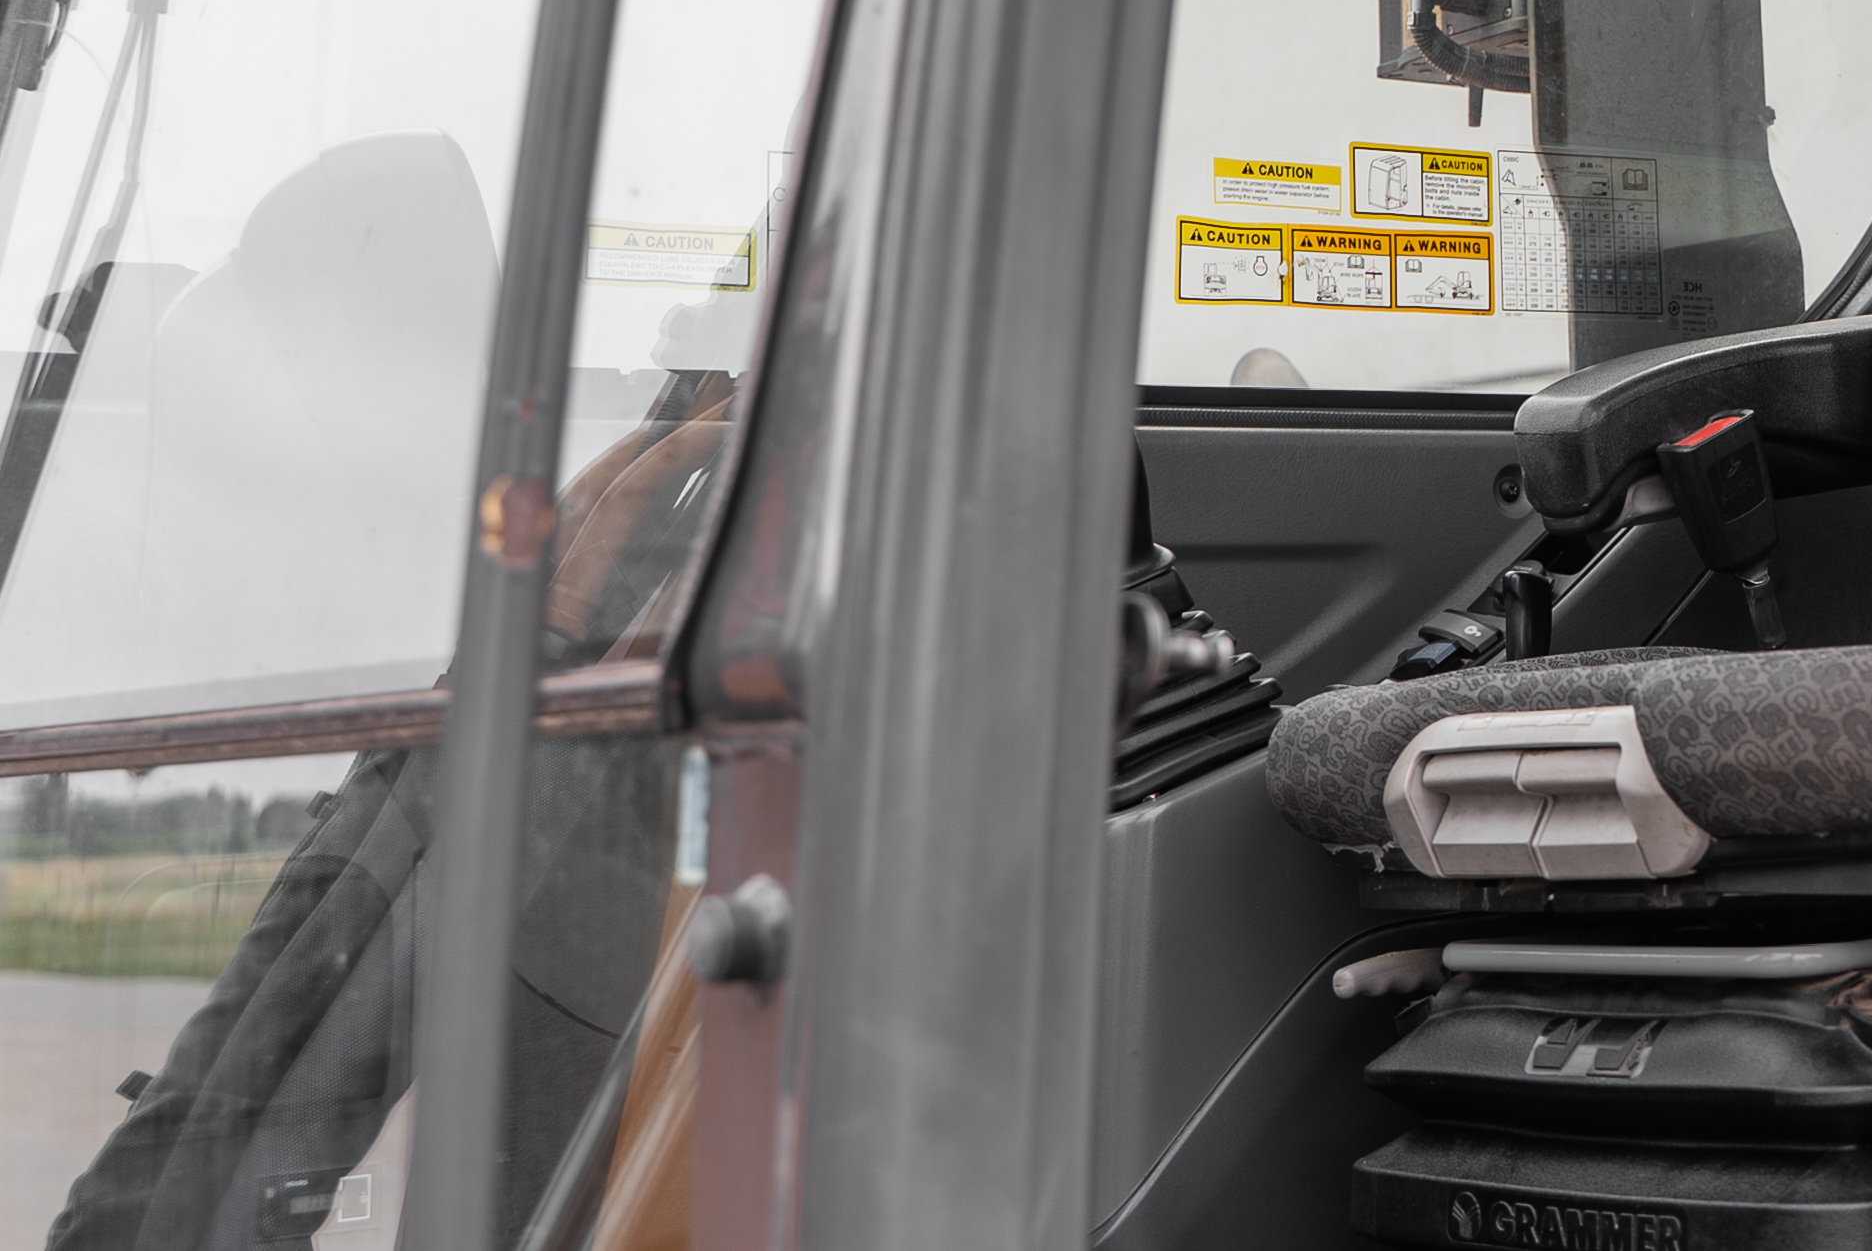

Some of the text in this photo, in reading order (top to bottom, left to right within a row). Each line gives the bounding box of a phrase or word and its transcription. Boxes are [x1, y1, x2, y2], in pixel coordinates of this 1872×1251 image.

[1258, 164, 1313, 179] CAUTION
[1441, 160, 1483, 171] CAUTION
[645, 236, 714, 250] CAUTION
[1207, 230, 1271, 245] CAUTION
[1316, 236, 1382, 251] WARNING
[1418, 240, 1481, 254] WARNING
[599, 252, 659, 261] RECOMMENDED
[599, 260, 645, 269] EQUIVALENT
[599, 268, 609, 276] TO
[1489, 1200, 1682, 1251] GRAMMER
